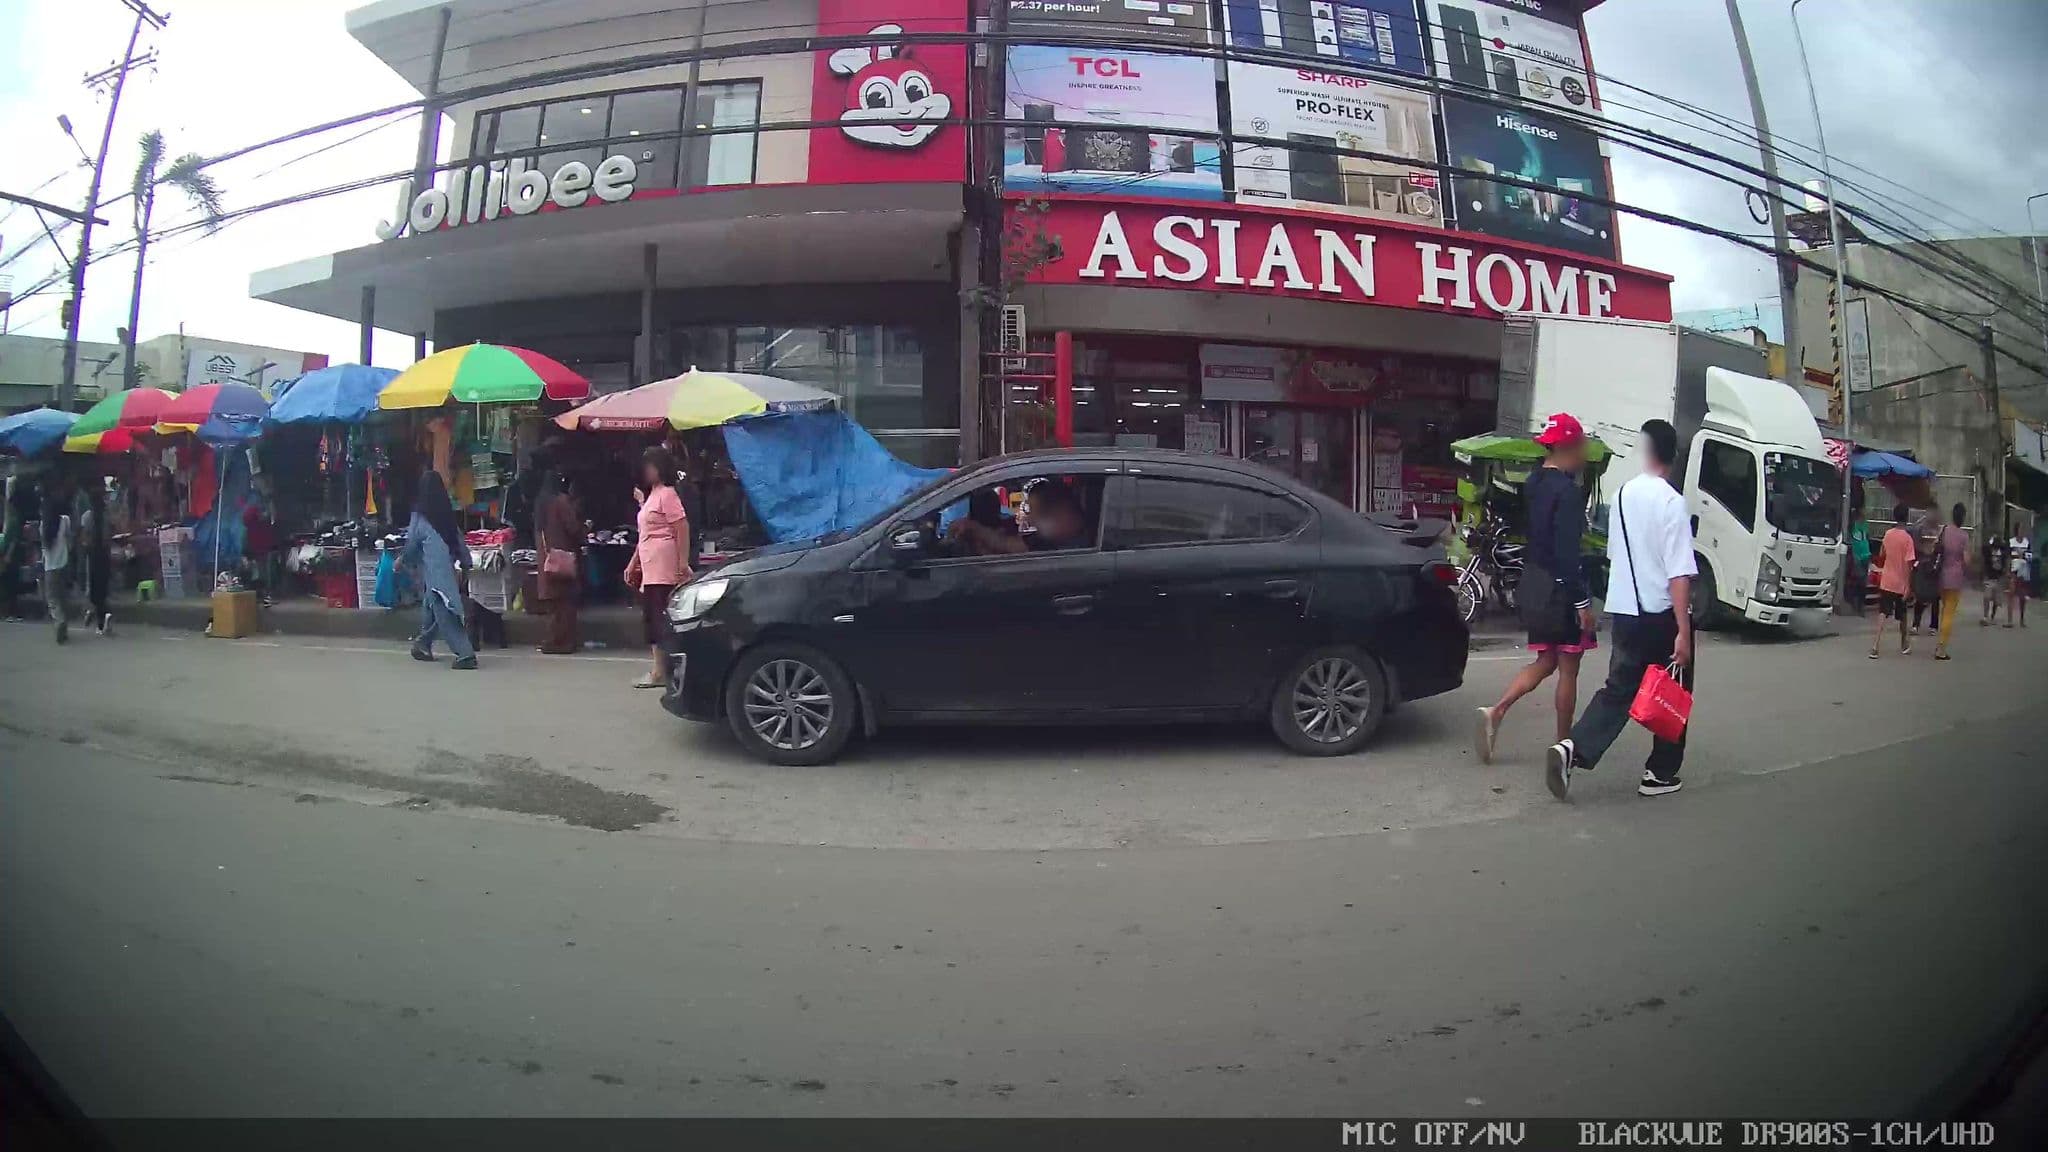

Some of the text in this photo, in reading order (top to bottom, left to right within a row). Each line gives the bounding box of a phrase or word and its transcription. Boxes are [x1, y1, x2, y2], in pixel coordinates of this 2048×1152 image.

[1044, 3, 1066, 12] per
[1067, 3, 1100, 13] hour!
[1068, 57, 1140, 77] TCL
[1297, 69, 1368, 88] SHARP
[1278, 87, 1309, 97] SUPERIOR
[1311, 91, 1330, 100] WASH
[1296, 98, 1375, 122] PRO-FLEX
[1496, 115, 1558, 140] Hisense
[375, 154, 638, 240] Jollibee
[1078, 210, 1616, 318] ASIAN HOME
